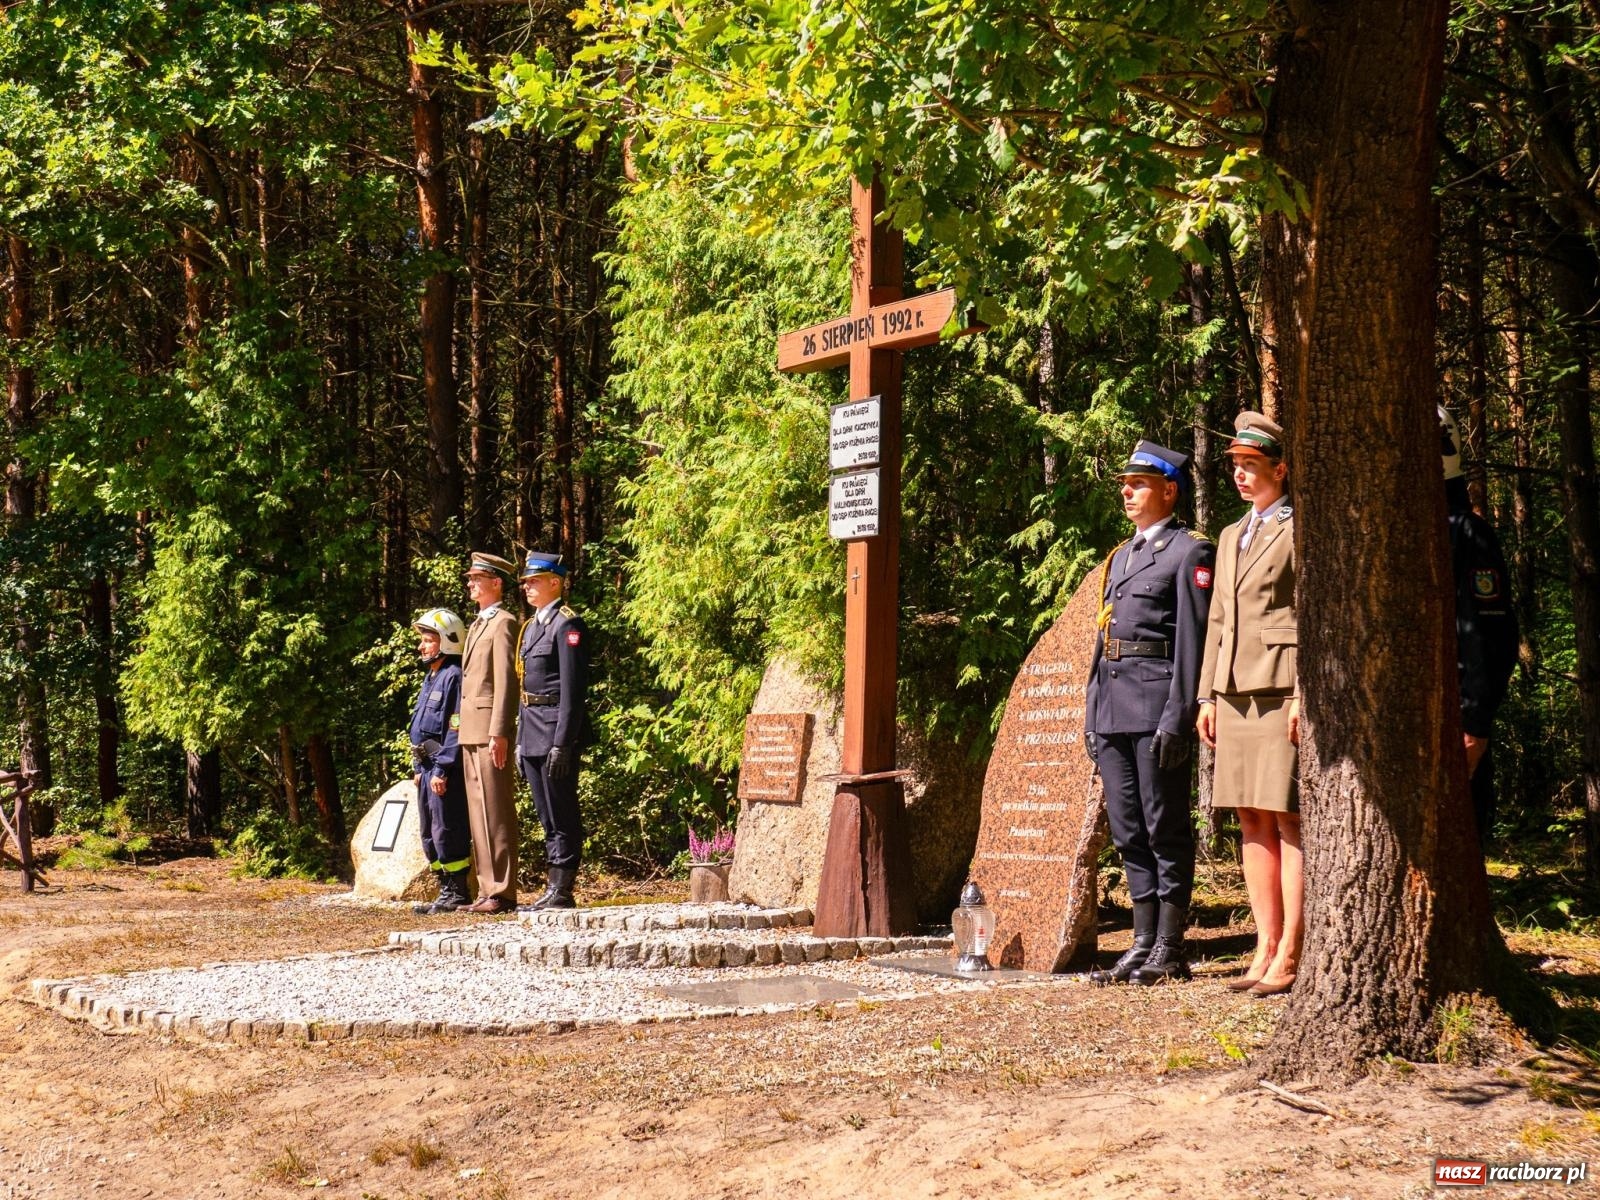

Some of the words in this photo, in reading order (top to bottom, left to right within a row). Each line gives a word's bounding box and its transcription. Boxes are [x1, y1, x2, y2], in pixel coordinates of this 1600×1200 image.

[803, 333, 816, 356] 26
[822, 313, 875, 352] SIERPIEŃ
[882, 307, 912, 336] 1992
[1030, 662, 1073, 675] TRAGEDIA
